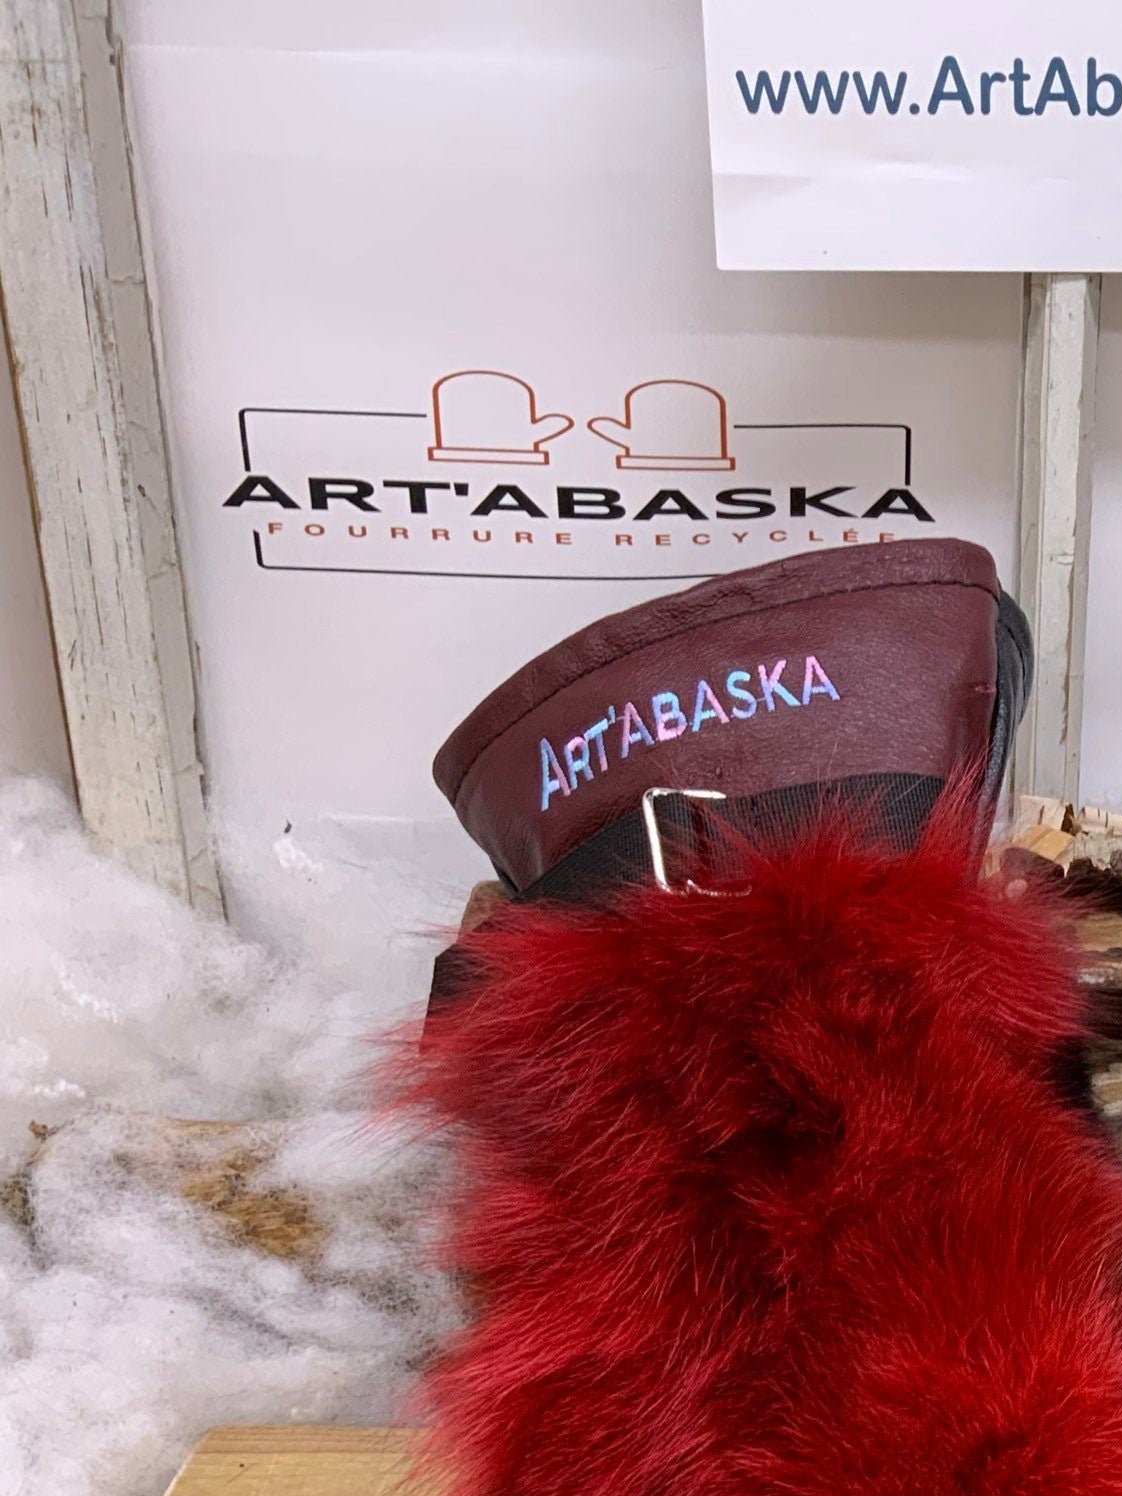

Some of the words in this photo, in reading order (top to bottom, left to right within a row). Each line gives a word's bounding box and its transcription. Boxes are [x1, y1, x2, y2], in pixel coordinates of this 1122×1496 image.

[221, 475, 936, 523] ART'ABASKA
[267, 522, 573, 546] FOURRURE
[614, 528, 895, 547] RECYCLÉE
[541, 655, 841, 812] ART'ABASKA
